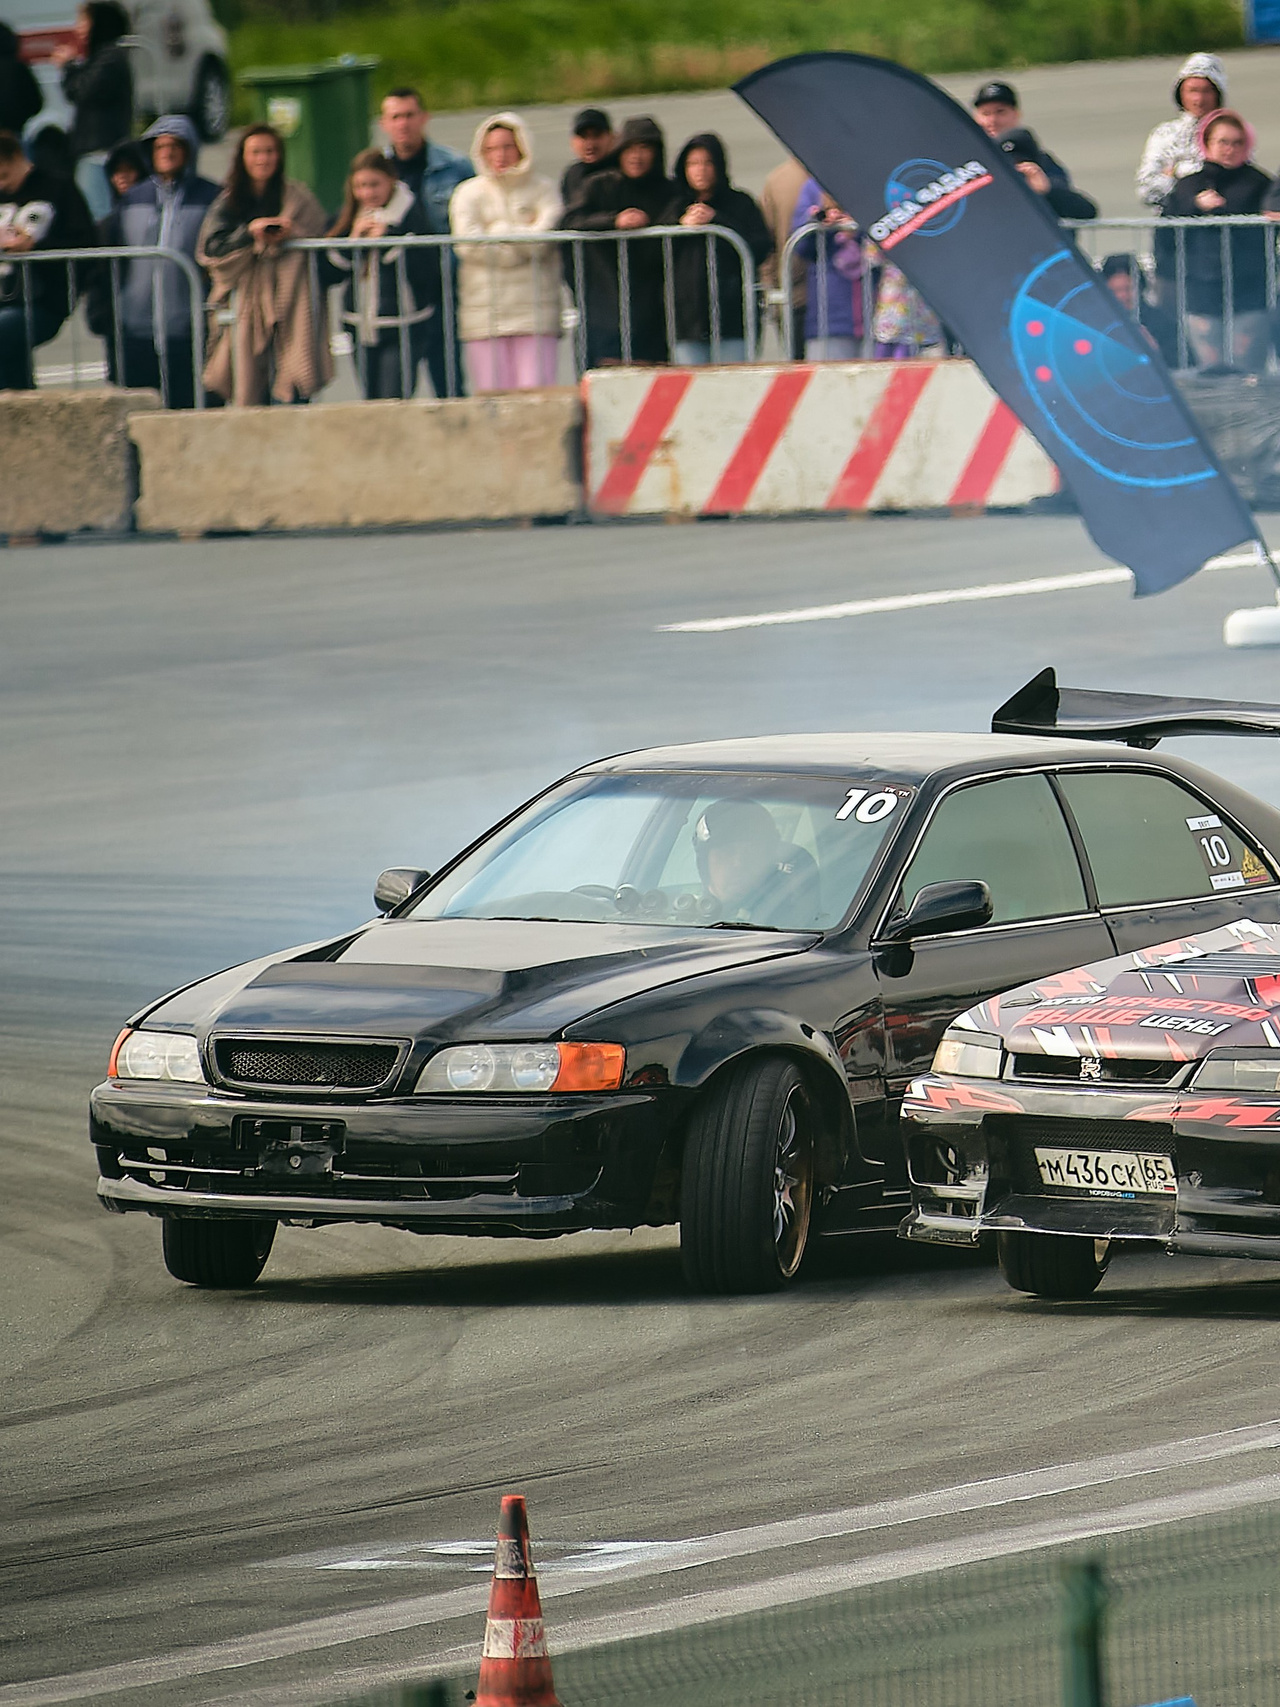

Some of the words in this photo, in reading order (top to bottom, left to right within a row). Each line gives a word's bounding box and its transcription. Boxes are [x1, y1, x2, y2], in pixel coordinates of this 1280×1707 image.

[835, 787, 899, 824] 10
[1200, 835, 1231, 868] 10
[1014, 1008, 1154, 1026] ВЫШЕ
[1138, 1013, 1232, 1037] ЦЕНЫ
[1095, 995, 1272, 1022] КАЧЕСТВО
[1046, 1154, 1141, 1188] М436СК
[1143, 1158, 1168, 1181] 65
[1146, 1180, 1164, 1190] RUS
